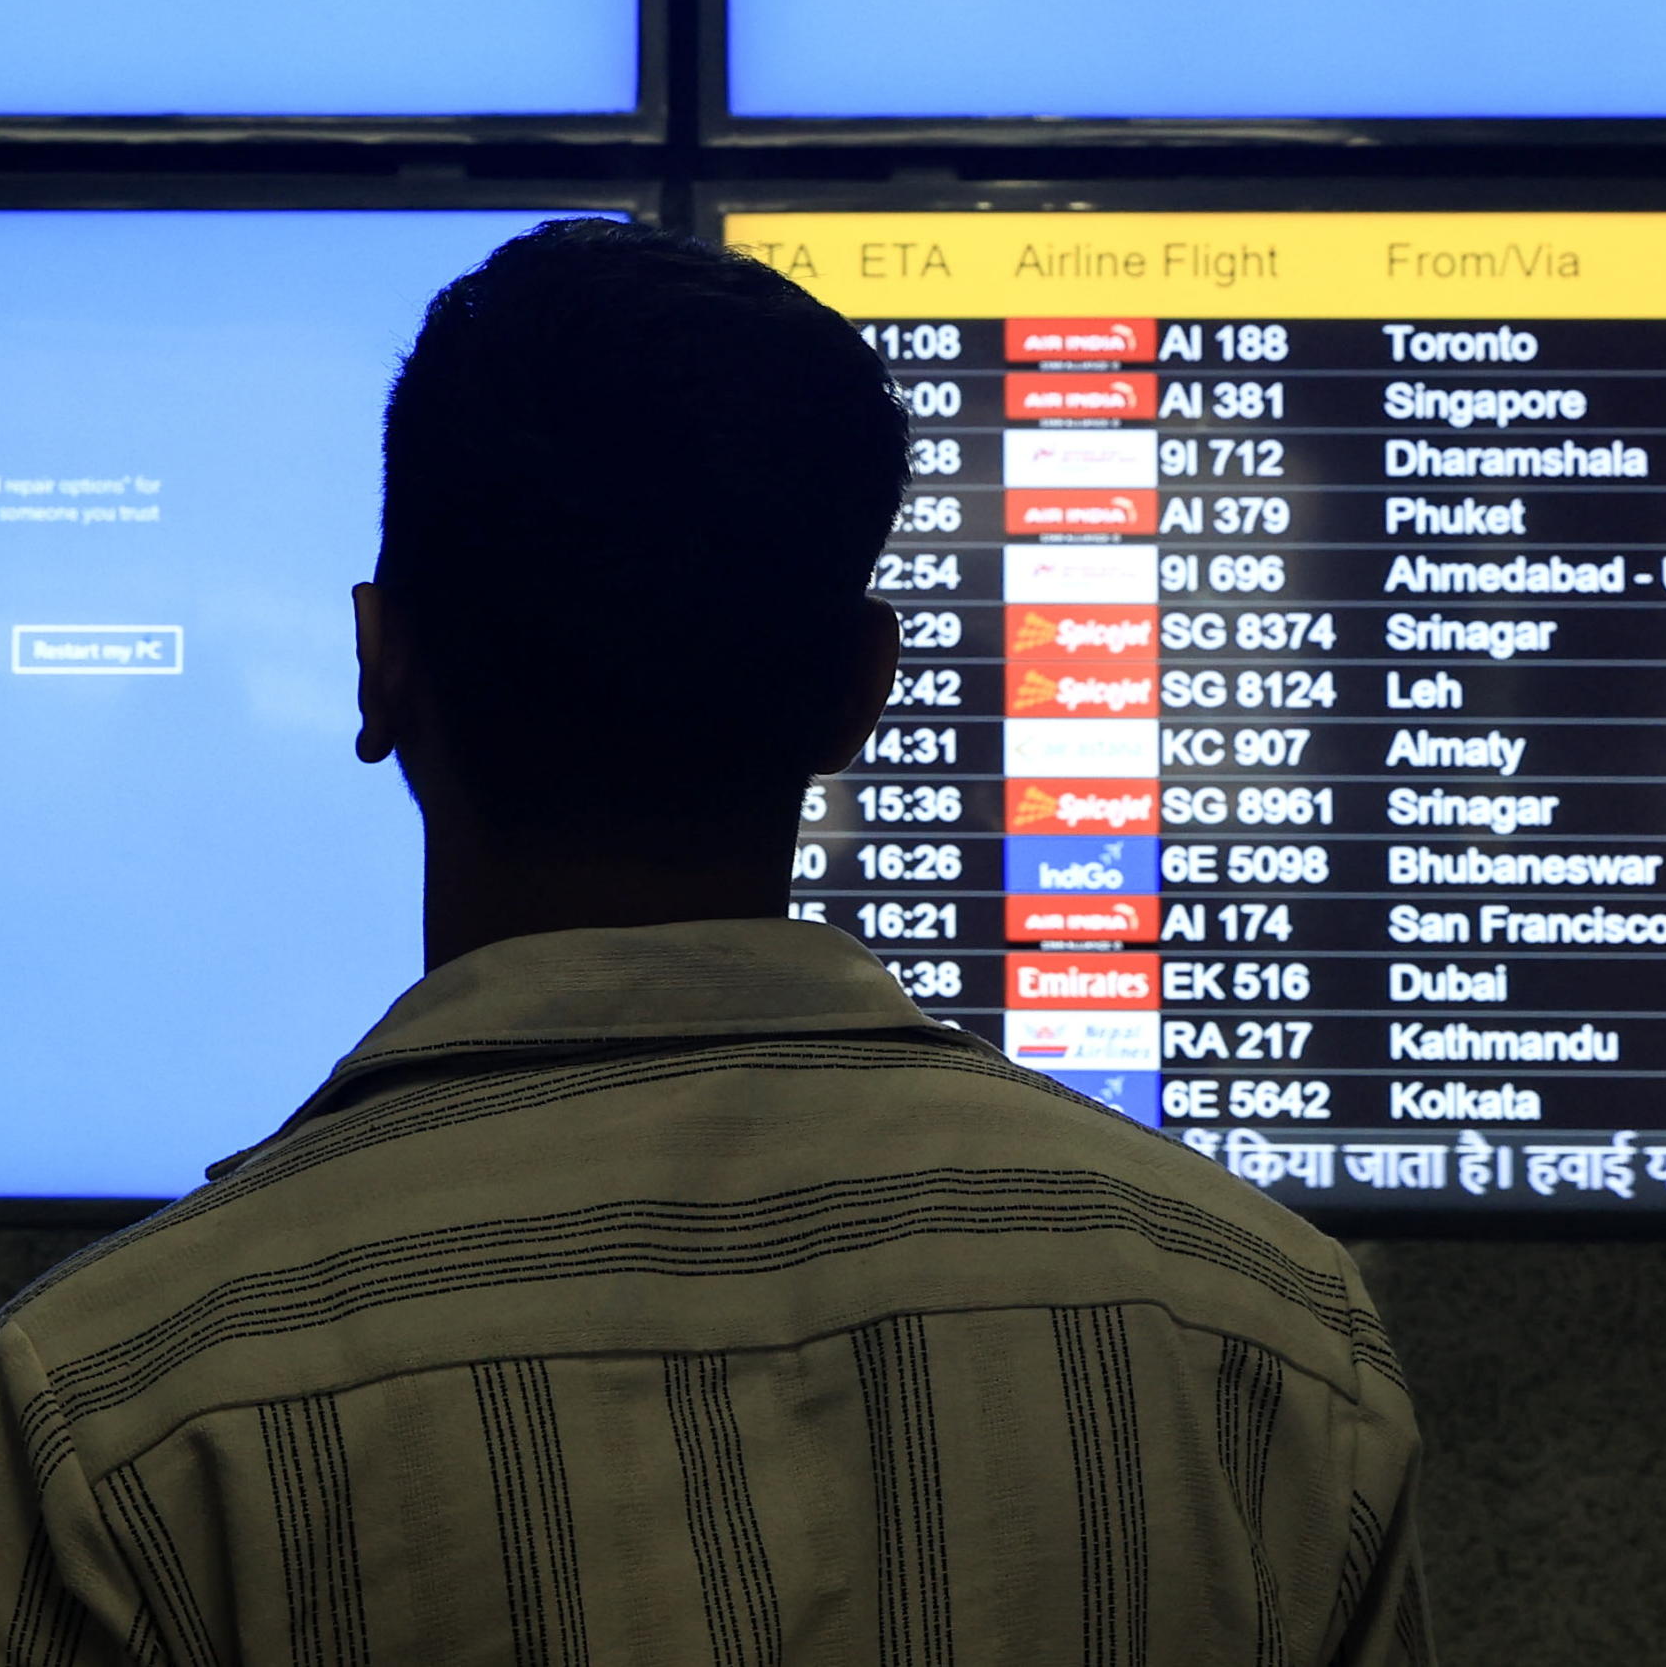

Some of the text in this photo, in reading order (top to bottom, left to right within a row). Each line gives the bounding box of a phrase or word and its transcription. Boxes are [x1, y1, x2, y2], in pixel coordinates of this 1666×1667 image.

[728, 242, 819, 278] TA
[860, 242, 952, 278] ETA
[1014, 242, 1147, 278] Airline
[1164, 242, 1279, 286] Flight
[1387, 241, 1582, 279] From/Via
[1159, 325, 1288, 360] AI 188
[1383, 325, 1537, 361] Toronto
[893, 382, 960, 416] :00
[1159, 382, 1282, 418] AI 381
[1385, 383, 1586, 427] Singapore
[1209, 440, 1283, 476] 712
[1386, 440, 1647, 476] Dharamshala
[892, 497, 961, 532] :56
[1159, 497, 1289, 534] AI 379
[1387, 498, 1525, 534] Phuket
[1209, 555, 1285, 591] 696
[1385, 556, 1624, 592] Ahmedabad
[1635, 574, 1652, 583] -
[896, 612, 961, 647] :29
[1161, 613, 1336, 649] SG 8374
[1387, 614, 1557, 659] Srinagar
[33, 640, 100, 660] Restart
[135, 641, 163, 660] PC
[1161, 671, 1336, 707] SG 8124
[1388, 672, 1462, 708] Leh
[865, 728, 955, 763] 14:31
[1163, 729, 1225, 765] KC
[1234, 729, 1310, 766] 907
[1387, 730, 1525, 775] Almaty
[858, 786, 961, 821] 15:36
[1162, 787, 1332, 824] SG 8961
[1388, 788, 1559, 834] Srinagar
[858, 845, 961, 879] 16:26
[1038, 861, 1124, 889] IndiGo
[1162, 846, 1328, 882] 6E 5098
[1389, 847, 1662, 884] Bhubaneswar
[858, 903, 956, 938] 16:21
[1161, 905, 1292, 941] AI 174
[1389, 905, 1469, 942] San
[886, 962, 961, 997] :38
[1017, 966, 1149, 998] Emirates
[1164, 963, 1309, 1000] EK 516
[1391, 964, 1506, 1001] Dubai
[1164, 1022, 1312, 1059] RA 217
[1391, 1023, 1618, 1060] Kathmandu
[1163, 1081, 1219, 1117] 6E
[1229, 1081, 1330, 1118] 5642
[1392, 1082, 1540, 1120] Kolkata
[1341, 1144, 1449, 1189] जाता
[1522, 1130, 1638, 1198] हवाई
